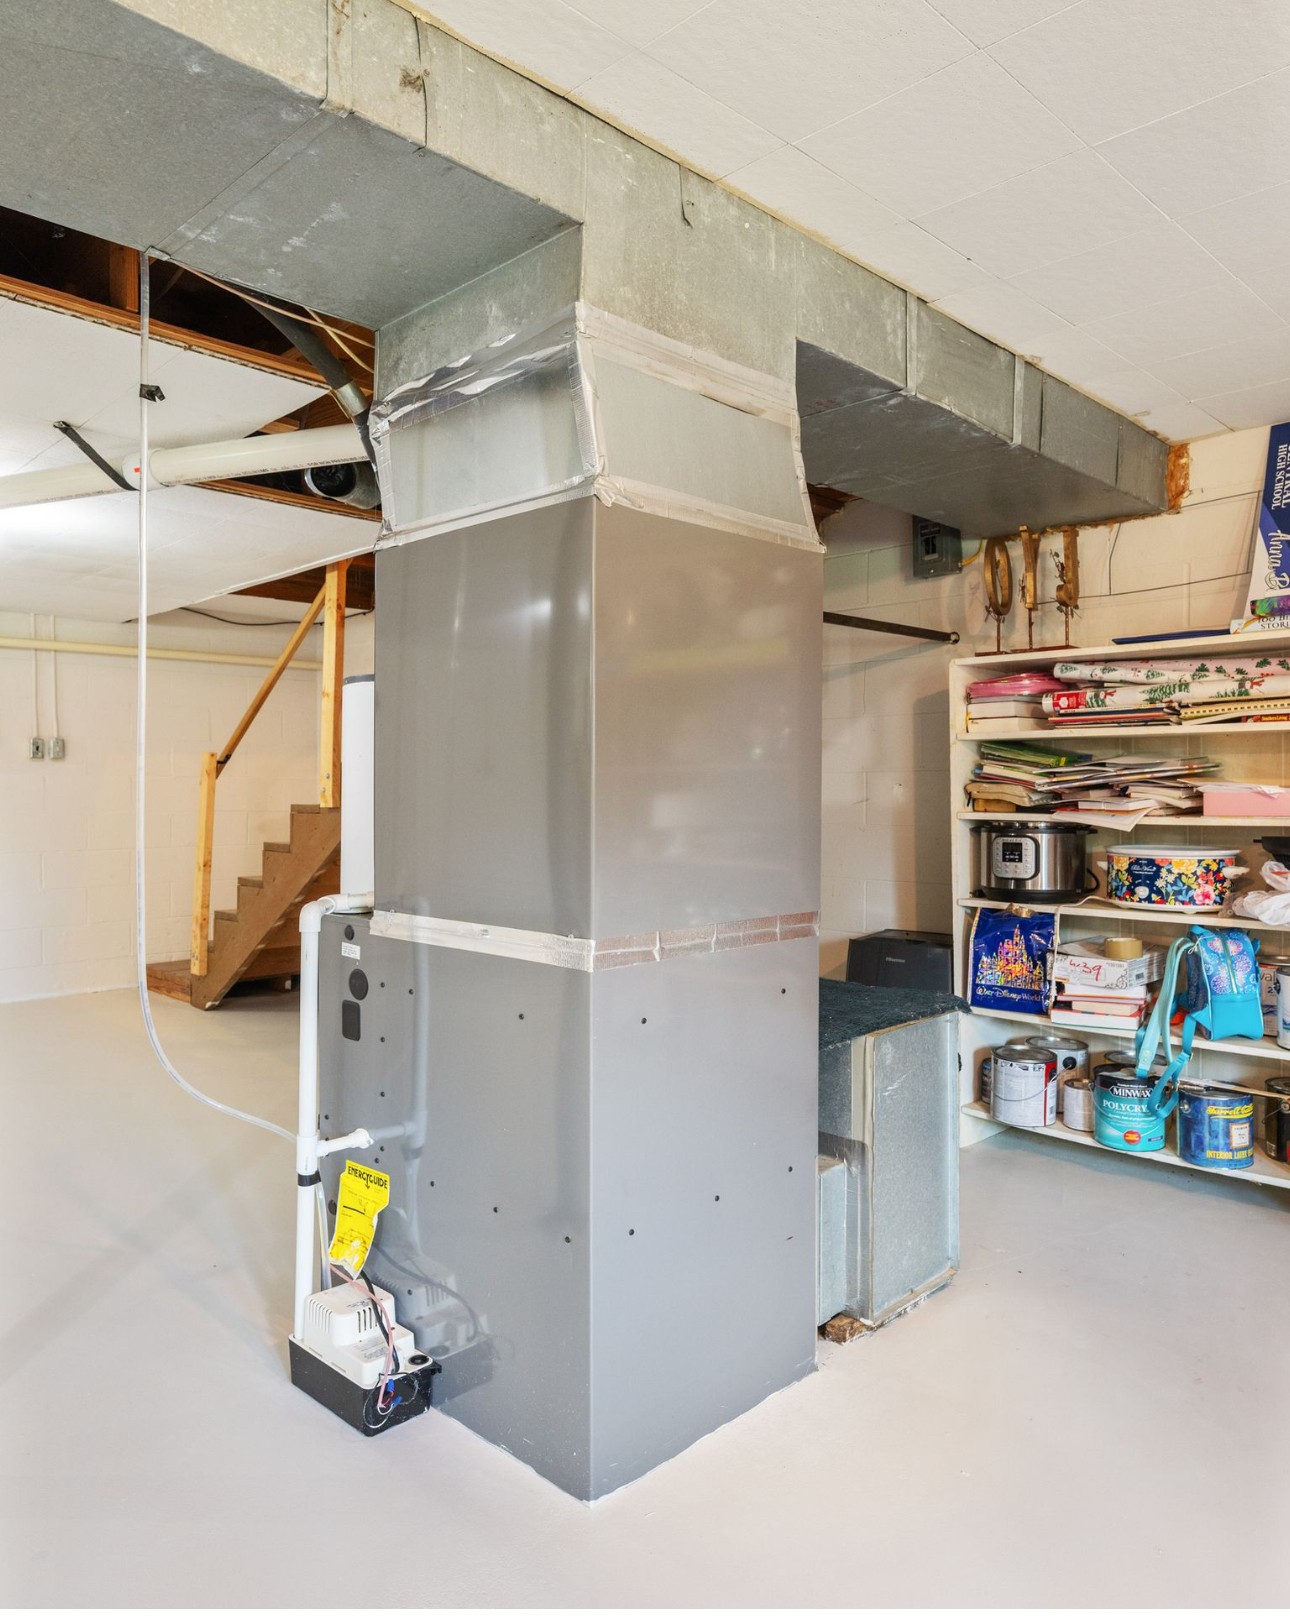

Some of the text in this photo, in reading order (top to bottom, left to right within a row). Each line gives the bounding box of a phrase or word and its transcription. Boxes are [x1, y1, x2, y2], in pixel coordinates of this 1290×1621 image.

[1271, 443, 1288, 510] HIGH SCHOOL
[1267, 529, 1290, 571] Anna
[1112, 1087, 1152, 1098] MINWAX
